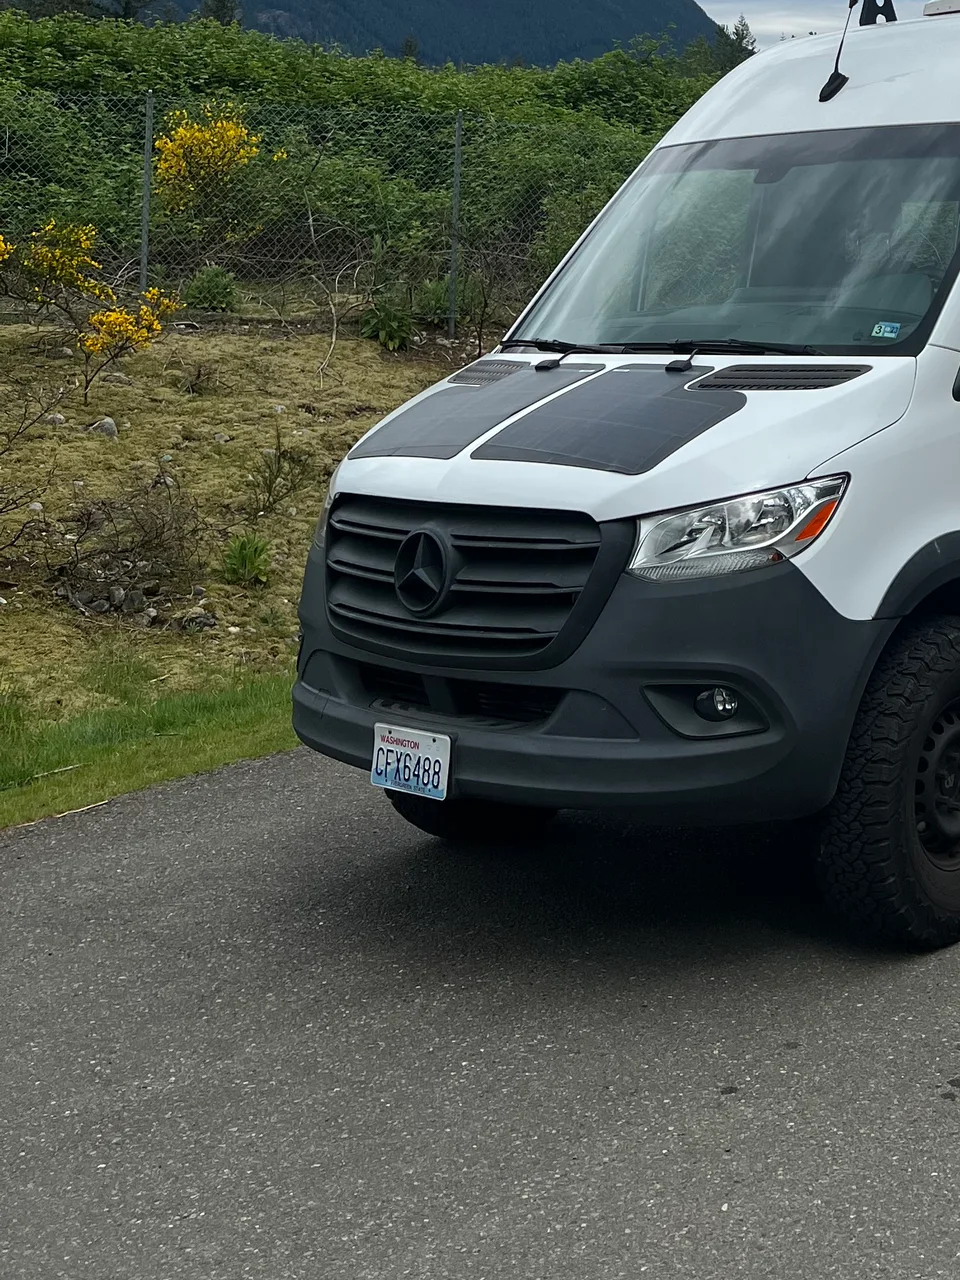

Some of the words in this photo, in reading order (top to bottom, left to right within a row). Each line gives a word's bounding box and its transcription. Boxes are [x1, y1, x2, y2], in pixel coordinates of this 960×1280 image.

[875, 325, 883, 334] 3
[380, 734, 420, 750] WASHINGTON
[375, 747, 442, 789] CFX6488
